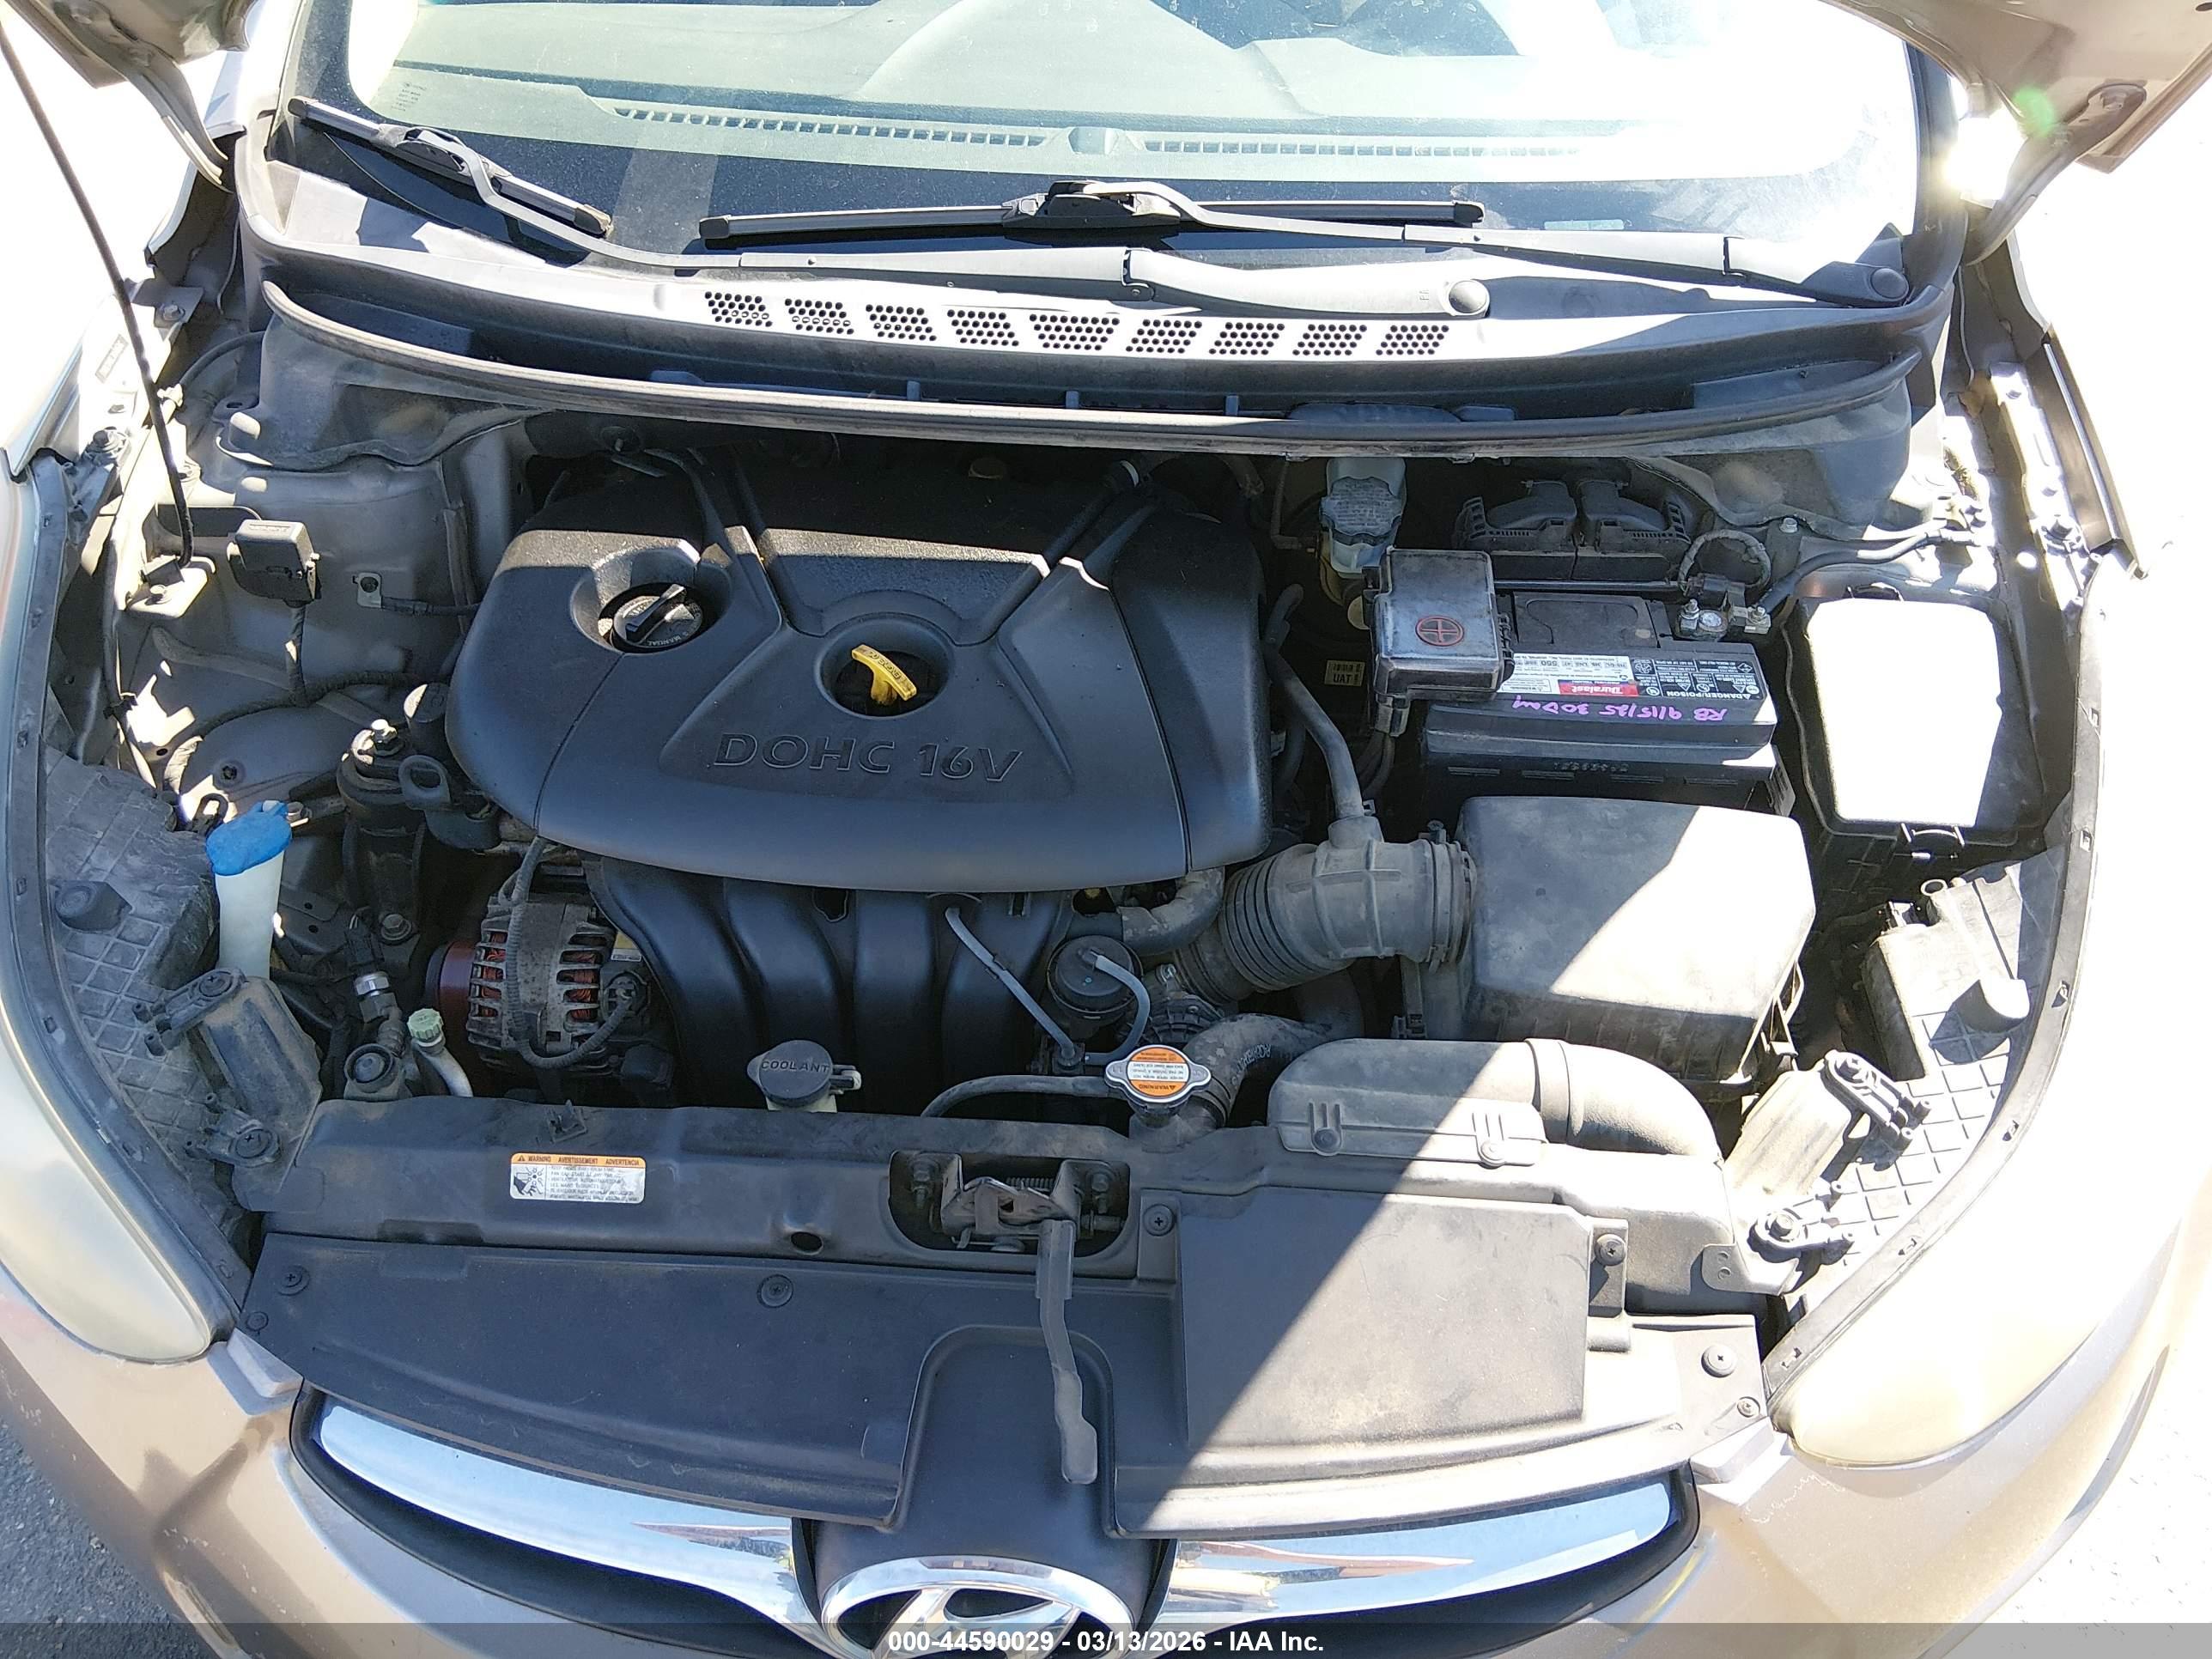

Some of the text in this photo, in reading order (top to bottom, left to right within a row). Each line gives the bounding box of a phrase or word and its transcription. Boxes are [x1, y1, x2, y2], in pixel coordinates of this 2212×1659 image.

[647, 635, 682, 646] MANUAL
[1571, 685, 1623, 695] Duralast
[1667, 690, 1743, 700] DANGER/POISON
[714, 732, 1023, 782] DOHC 16V
[761, 1060, 830, 1073] COOLANT
